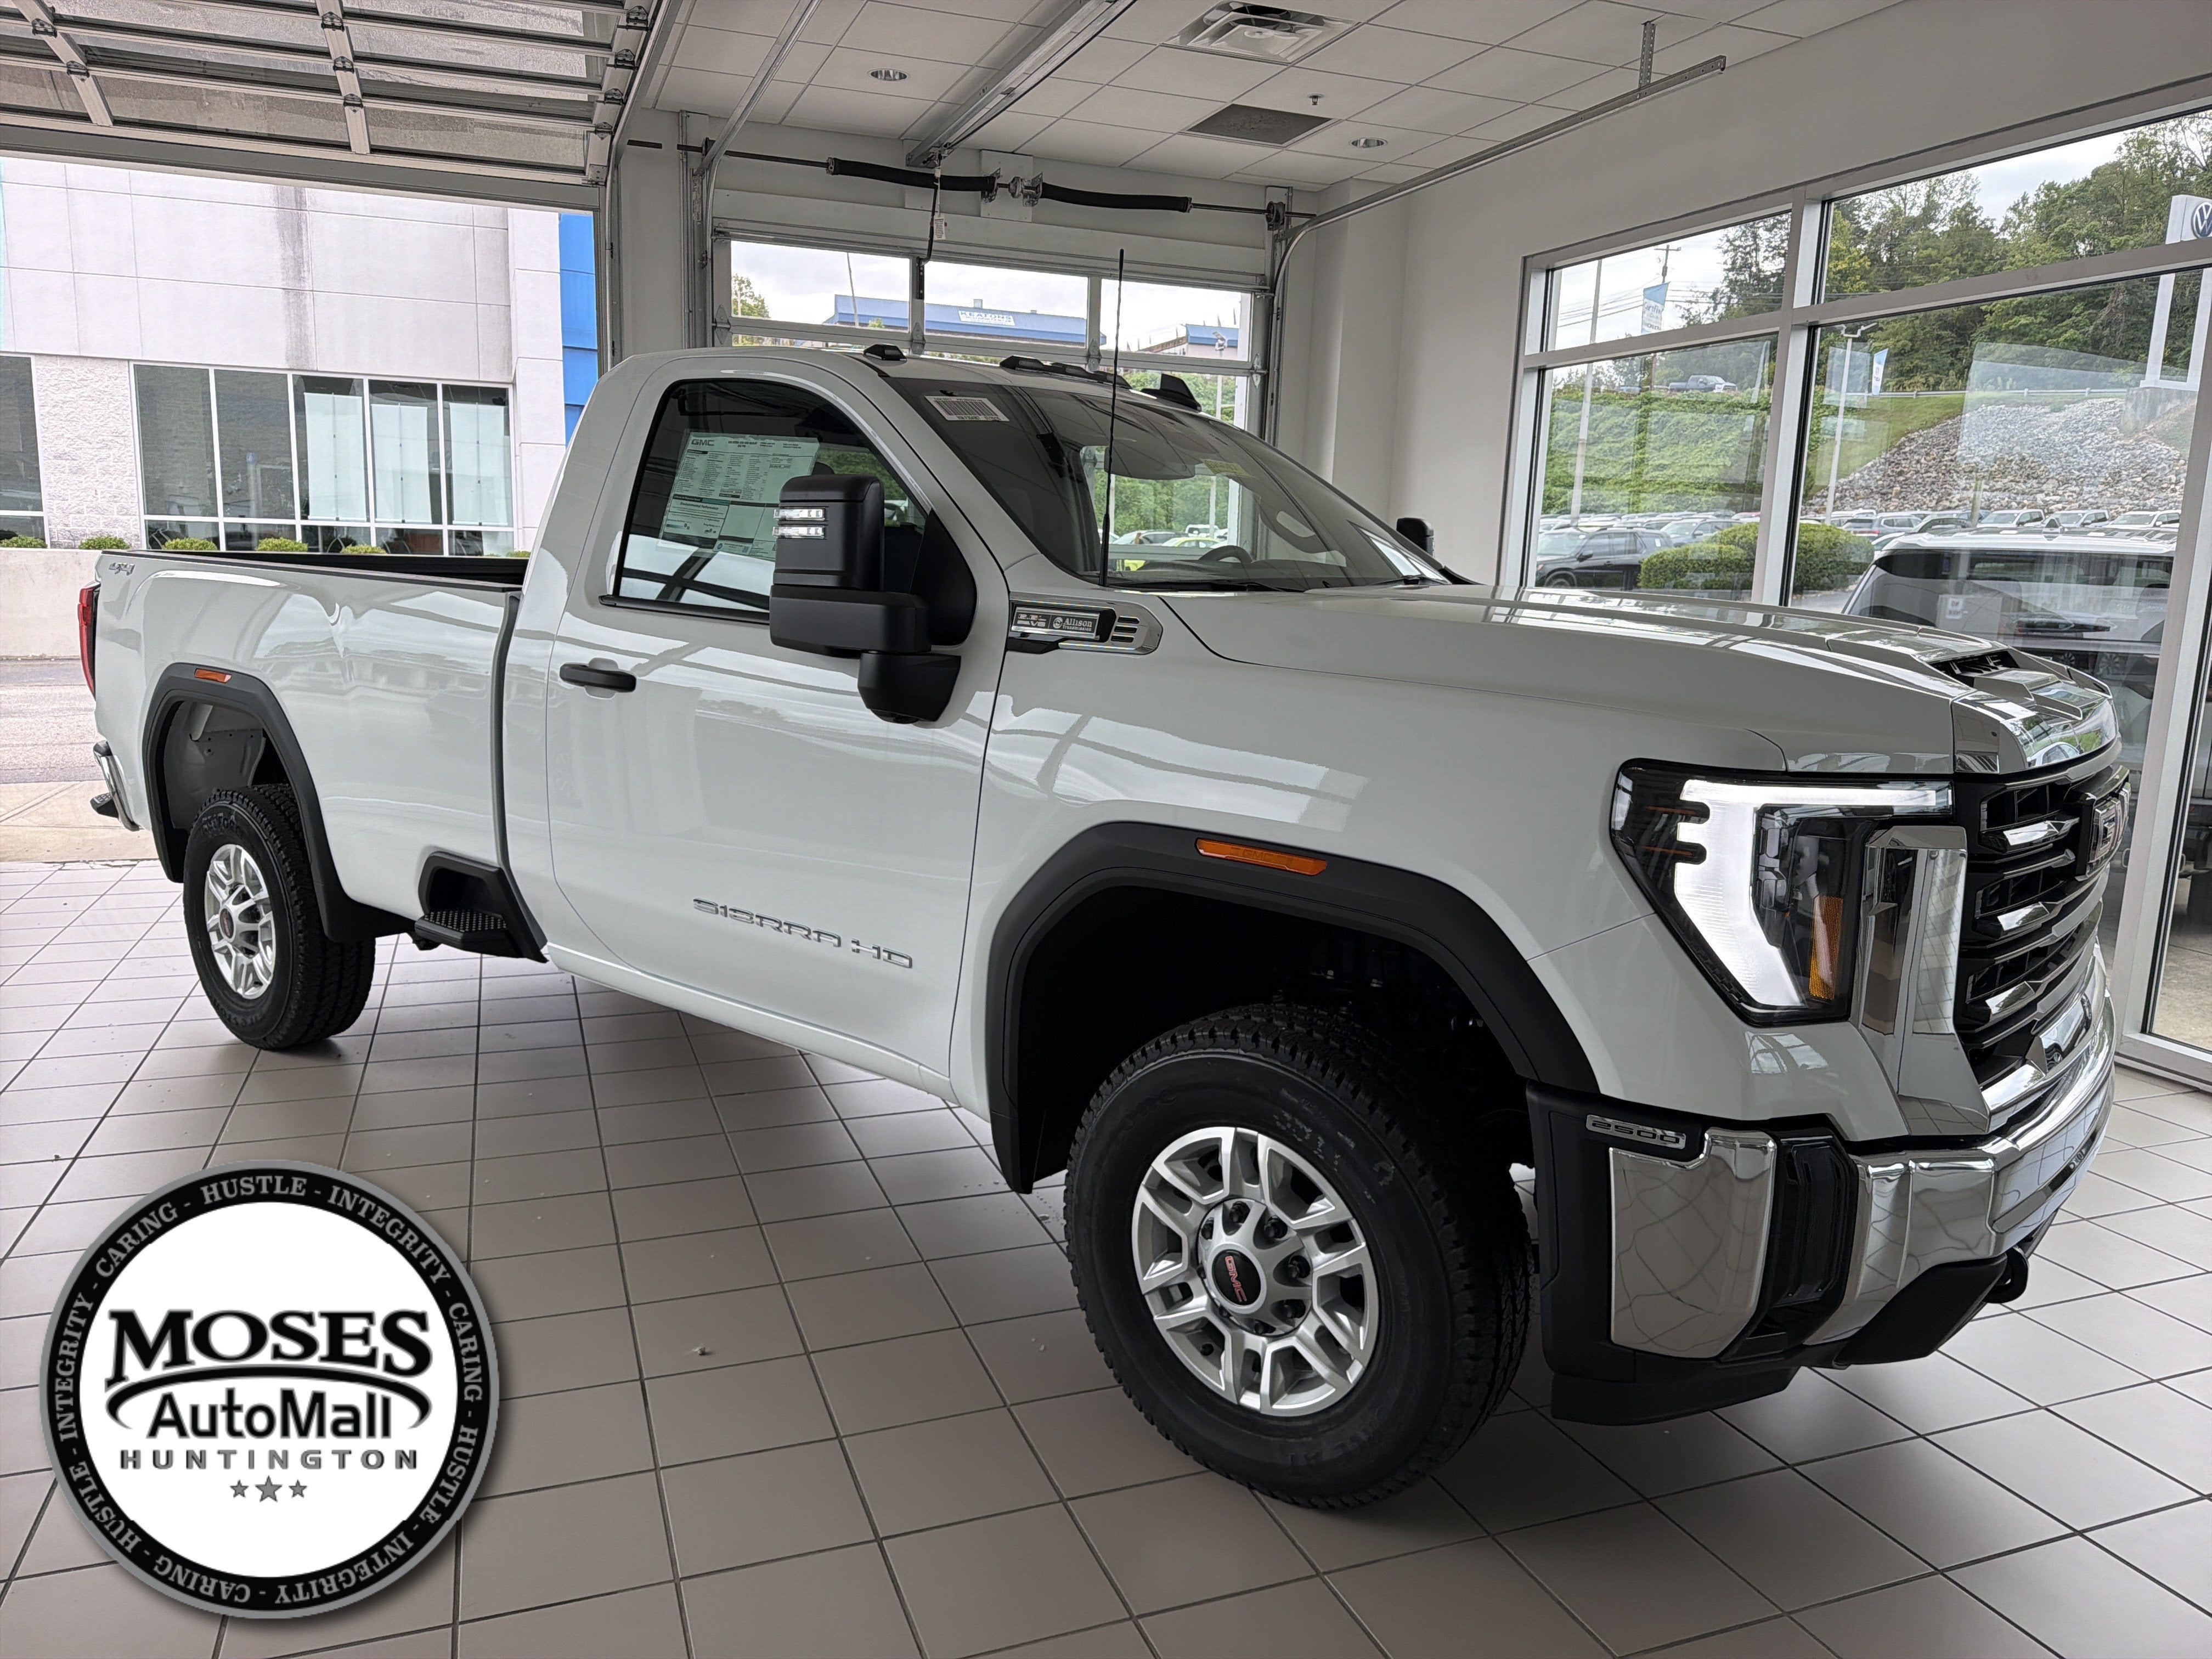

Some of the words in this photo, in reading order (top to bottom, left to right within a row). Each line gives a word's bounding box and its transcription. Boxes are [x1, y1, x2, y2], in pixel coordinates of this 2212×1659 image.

[1063, 618, 1092, 627] Allison
[693, 898, 842, 947] SIERRA
[851, 938, 912, 969] HD
[1592, 1120, 1680, 1144] 2500
[1225, 1256, 1247, 1302] GMC
